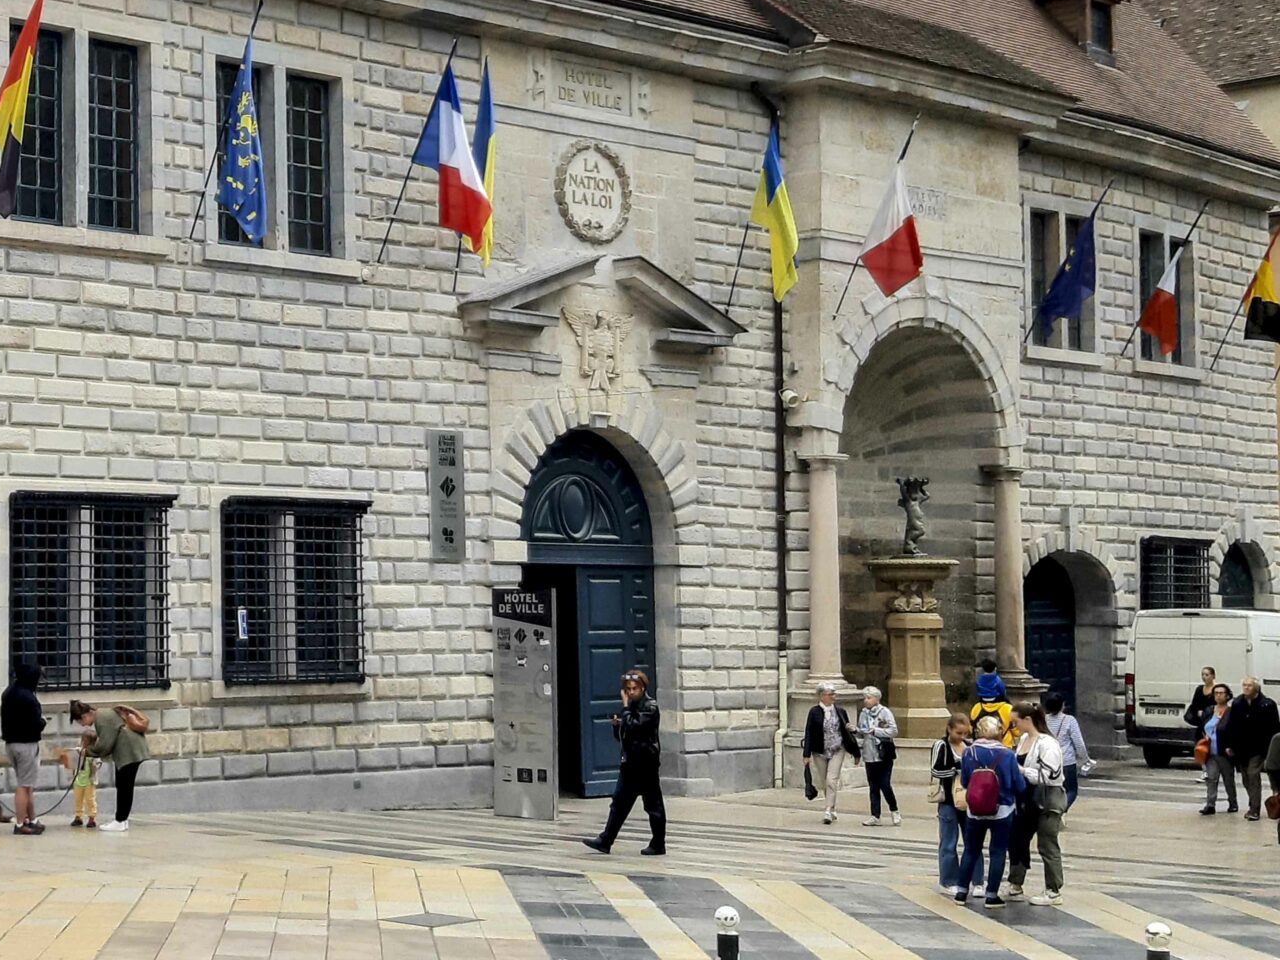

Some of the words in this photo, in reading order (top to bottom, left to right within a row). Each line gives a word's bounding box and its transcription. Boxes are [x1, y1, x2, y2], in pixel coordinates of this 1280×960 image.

[558, 85, 577, 103] DE
[582, 89, 622, 111] VILLE
[583, 158, 600, 174] LA
[568, 173, 615, 193] NATION
[571, 190, 589, 207] LA
[591, 193, 613, 209] LOI
[504, 589, 539, 603] HÔTEL
[498, 603, 513, 614] DE
[515, 603, 545, 614] VILLE
